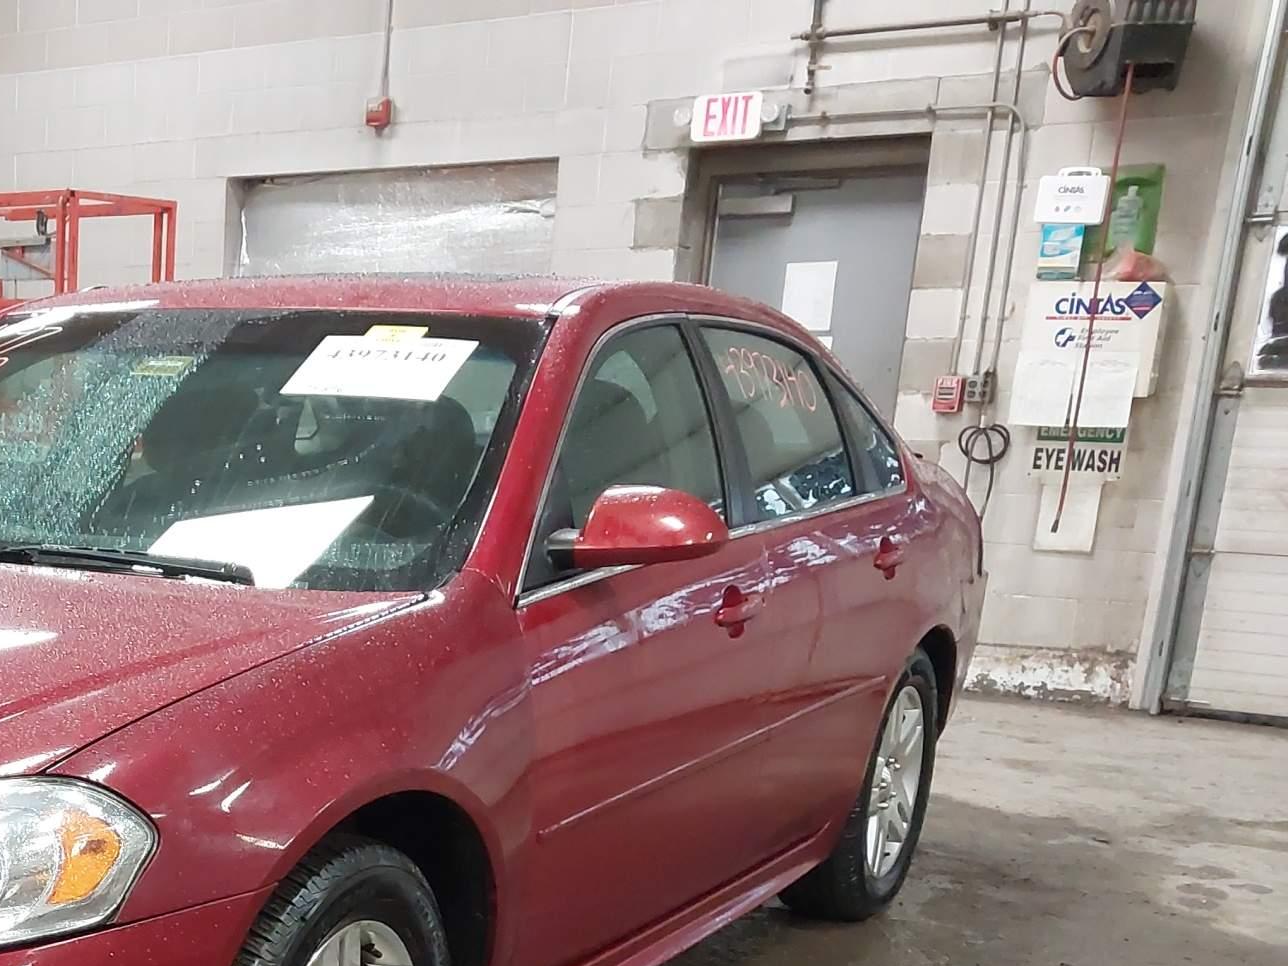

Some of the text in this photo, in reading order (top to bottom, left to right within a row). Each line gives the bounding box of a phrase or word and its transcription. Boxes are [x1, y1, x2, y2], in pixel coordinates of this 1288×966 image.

[703, 95, 753, 137] EXIT
[1055, 291, 1127, 316] CINTAS
[327, 348, 448, 362] 43973140
[1040, 426, 1123, 439] EMEGENCY
[1032, 447, 1122, 473] EYE WASH
